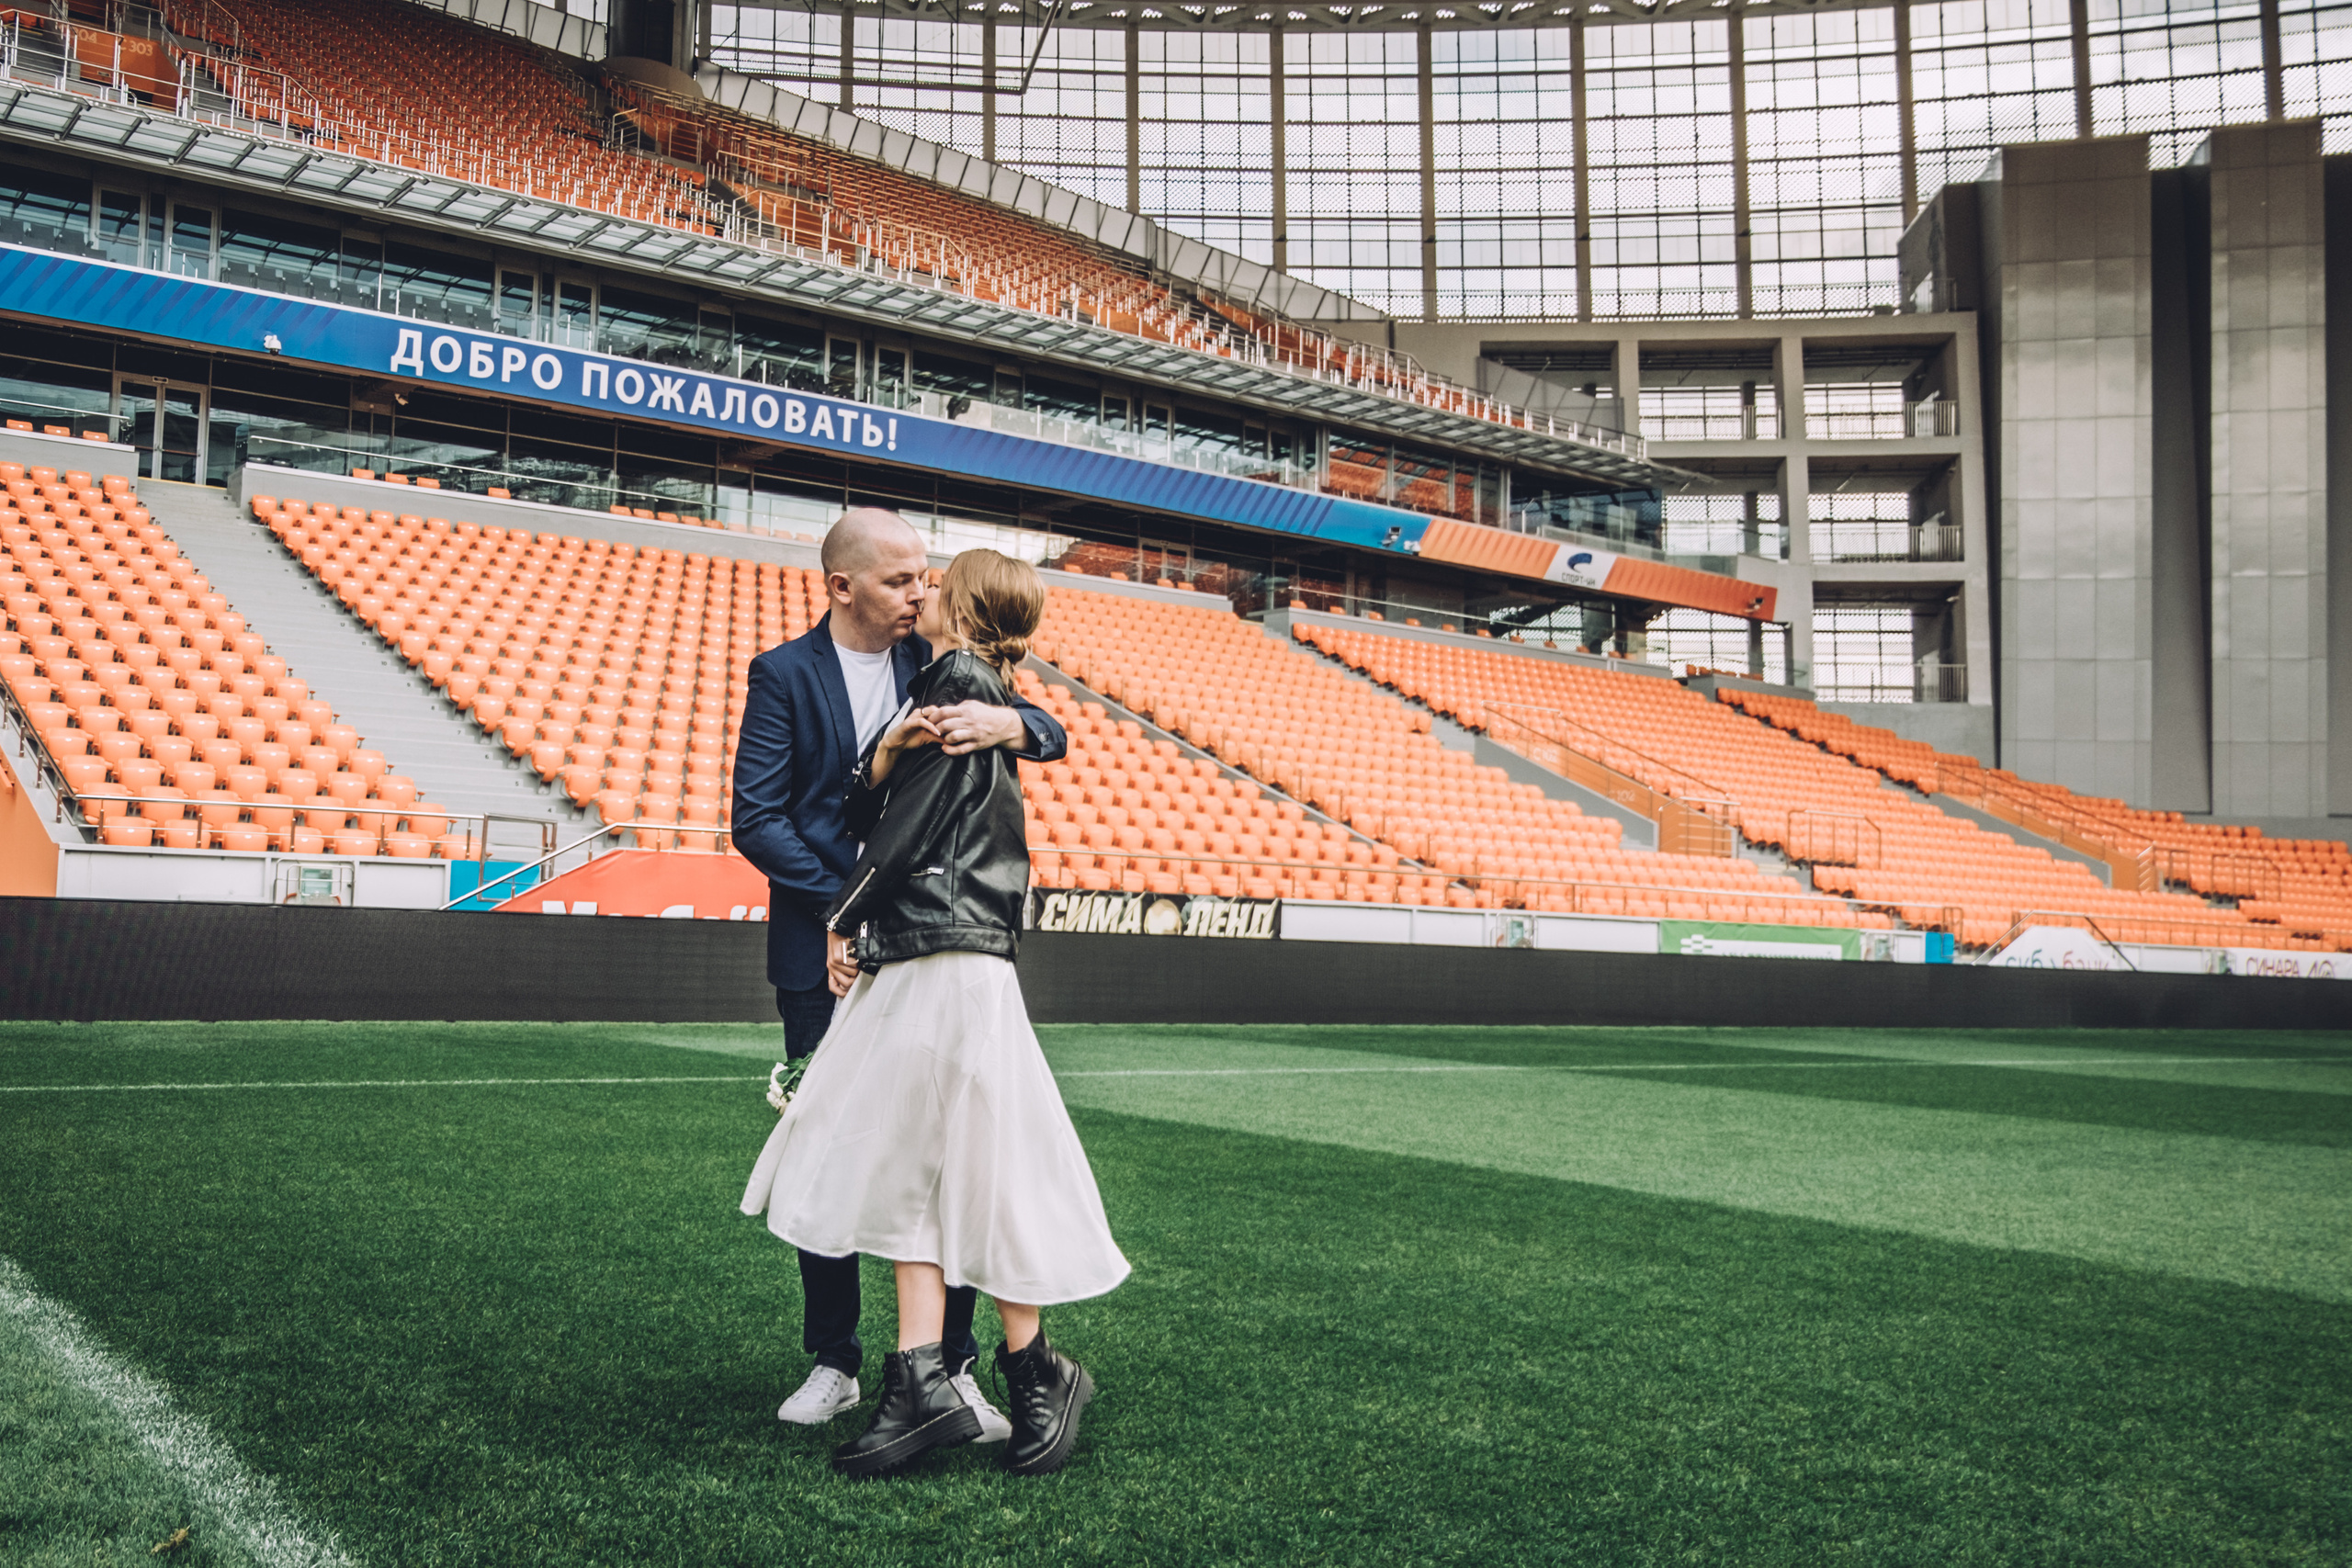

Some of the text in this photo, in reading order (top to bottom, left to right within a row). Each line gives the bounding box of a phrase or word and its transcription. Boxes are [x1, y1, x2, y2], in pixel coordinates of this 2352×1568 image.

[129, 40, 153, 56] 303
[390, 328, 898, 452] ДОБРО ПОЖАЛОВАТЬ!
[1040, 893, 1278, 939] СИМА ЛЕНД
